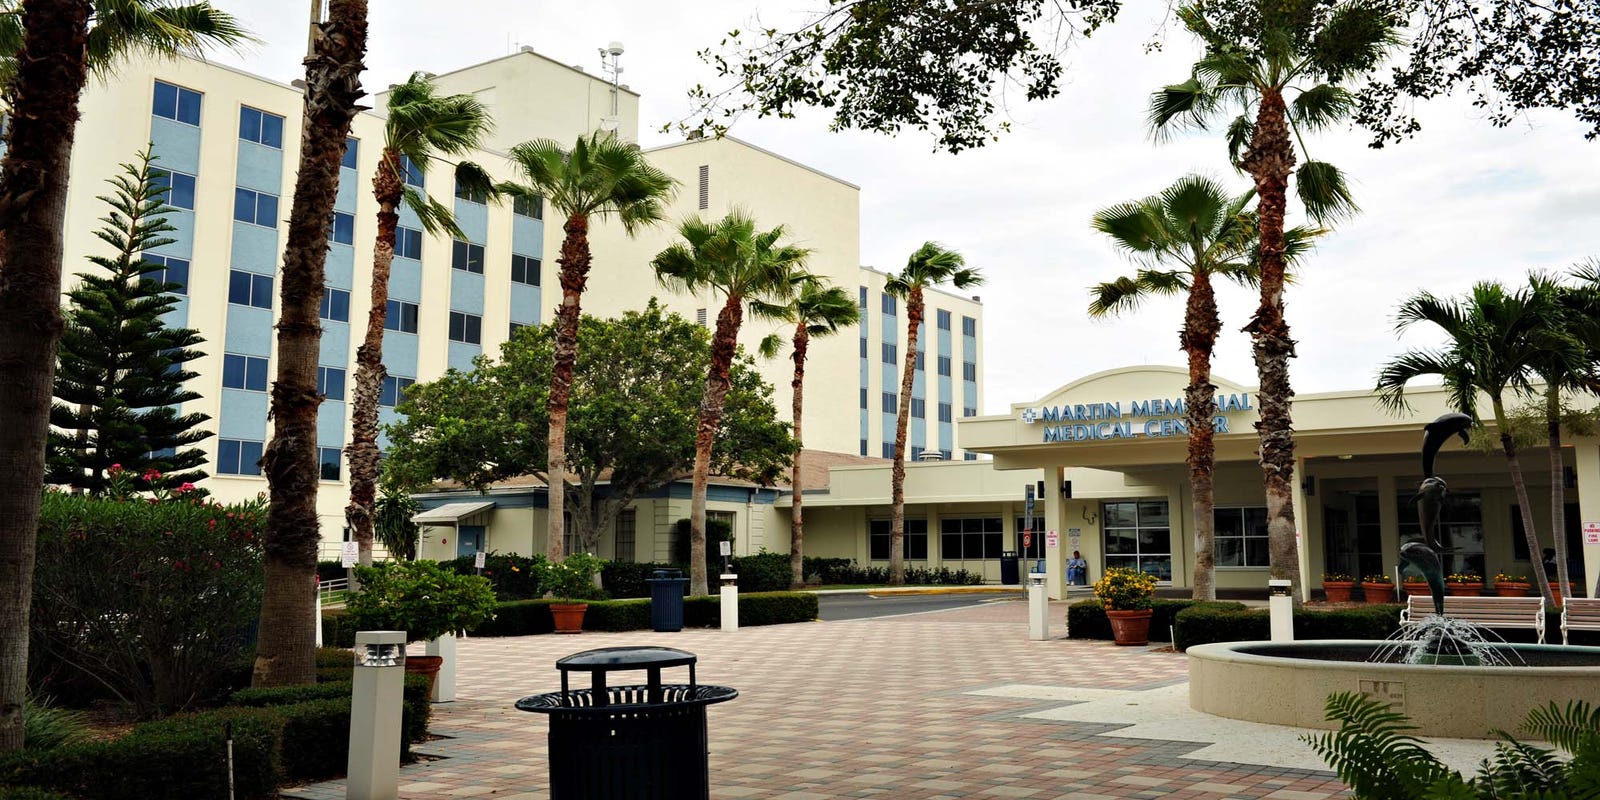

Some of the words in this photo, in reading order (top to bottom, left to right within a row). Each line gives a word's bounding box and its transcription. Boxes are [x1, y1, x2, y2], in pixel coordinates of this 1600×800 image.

[1042, 402, 1120, 422] MARTIN
[1131, 393, 1253, 417] MEMIAL
[1043, 422, 1136, 442] MEDICAL
[1144, 416, 1228, 437] CENR
